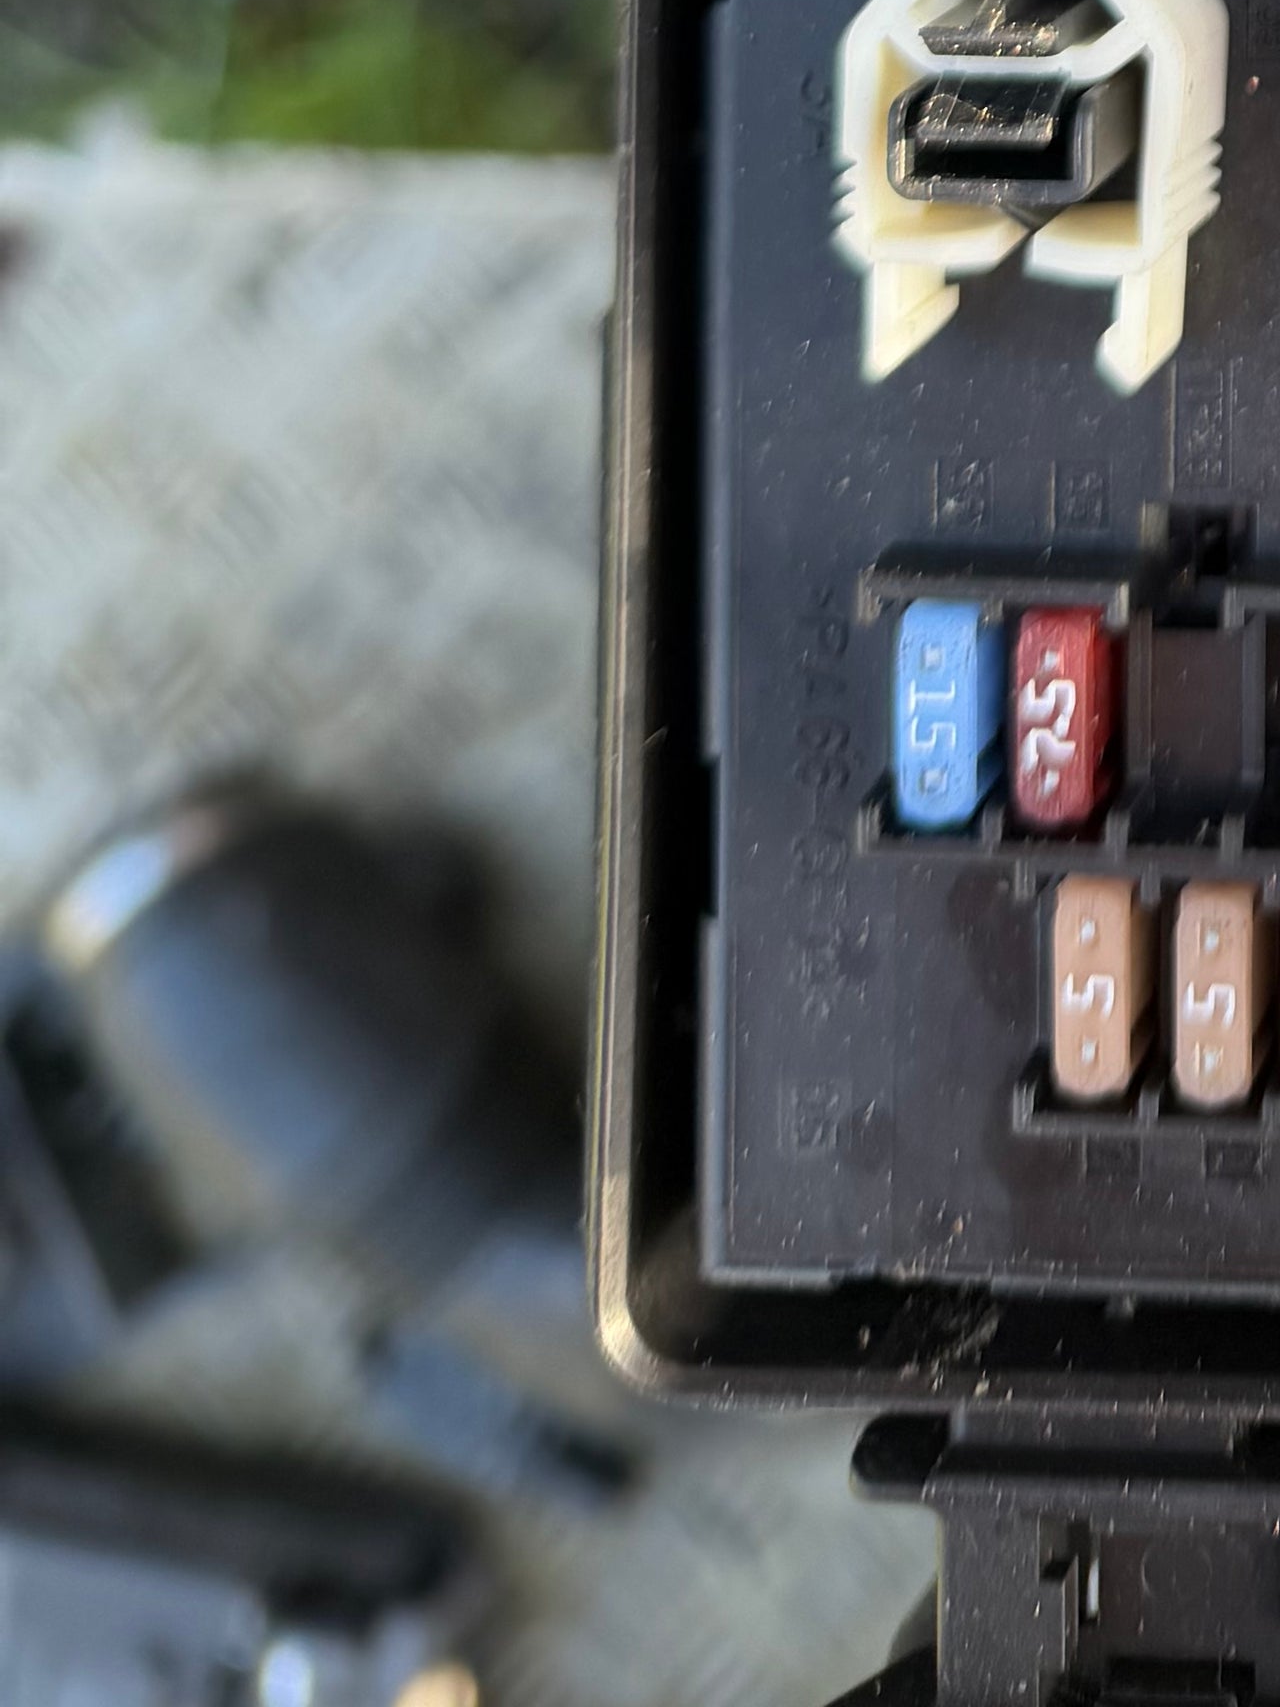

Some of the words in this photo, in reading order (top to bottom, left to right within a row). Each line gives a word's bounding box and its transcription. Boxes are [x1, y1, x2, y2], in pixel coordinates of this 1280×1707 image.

[907, 679, 956, 751] 15
[1062, 972, 1115, 1018] 5
[1183, 981, 1236, 1027] 5
